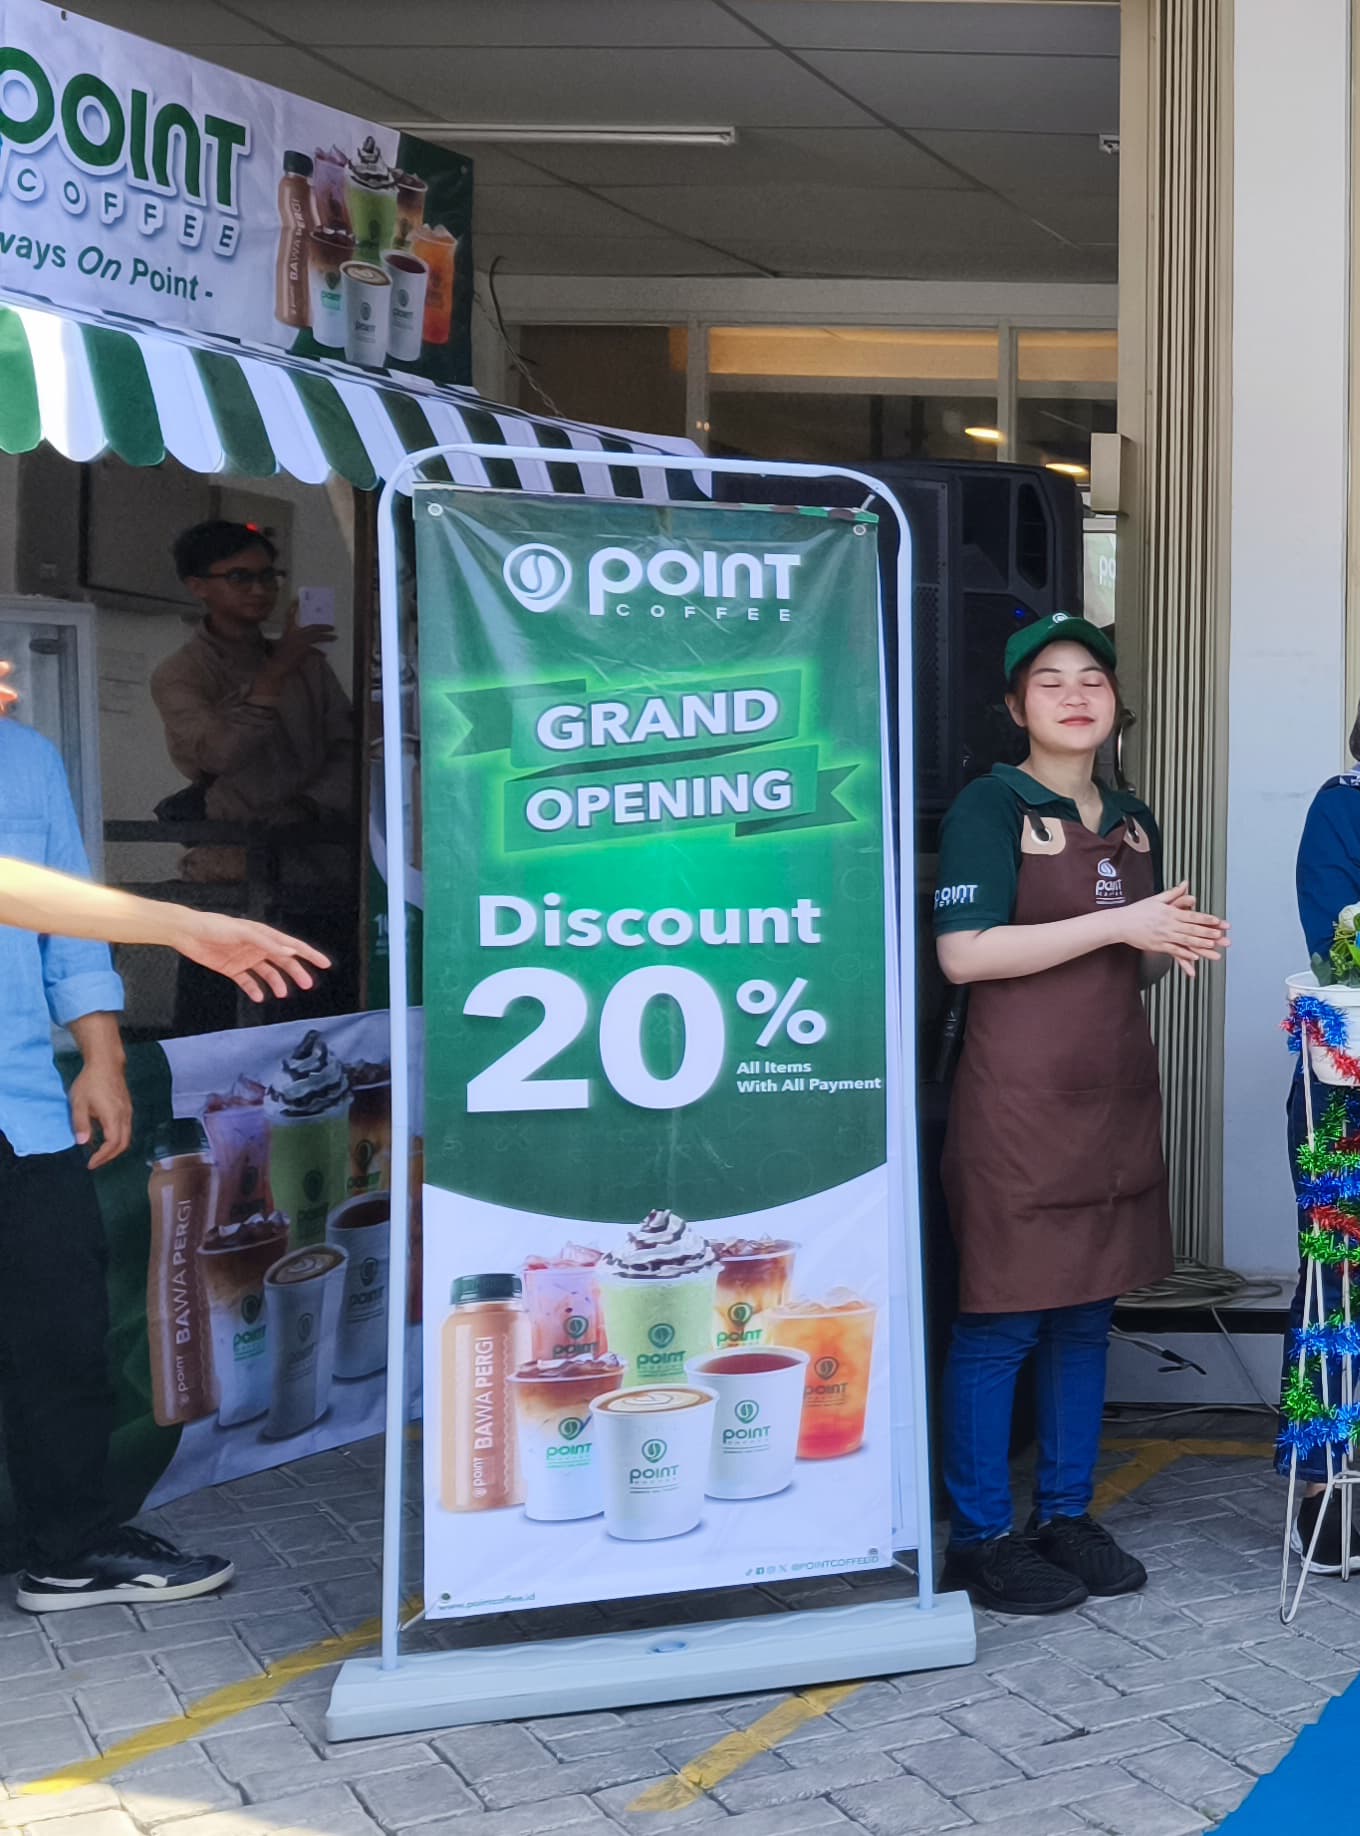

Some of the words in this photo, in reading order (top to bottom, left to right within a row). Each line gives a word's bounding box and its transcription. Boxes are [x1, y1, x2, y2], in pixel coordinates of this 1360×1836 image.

[18, 168, 234, 248] COFFEE
[78, 246, 122, 281] On
[130, 257, 199, 301] Point
[616, 604, 791, 622] COFFEE
[537, 688, 779, 751] GRAND
[525, 769, 792, 830] OPENING
[478, 893, 822, 947] Discount
[736, 1060, 760, 1075] All
[763, 1060, 812, 1075] Items
[736, 1078, 777, 1093] With
[781, 1078, 805, 1092] All
[808, 1076, 882, 1095] Payment
[173, 1199, 192, 1266] PERGI
[173, 1269, 191, 1345] BAWA
[474, 1336, 494, 1389] PERGI
[474, 1390, 493, 1450] BAWA
